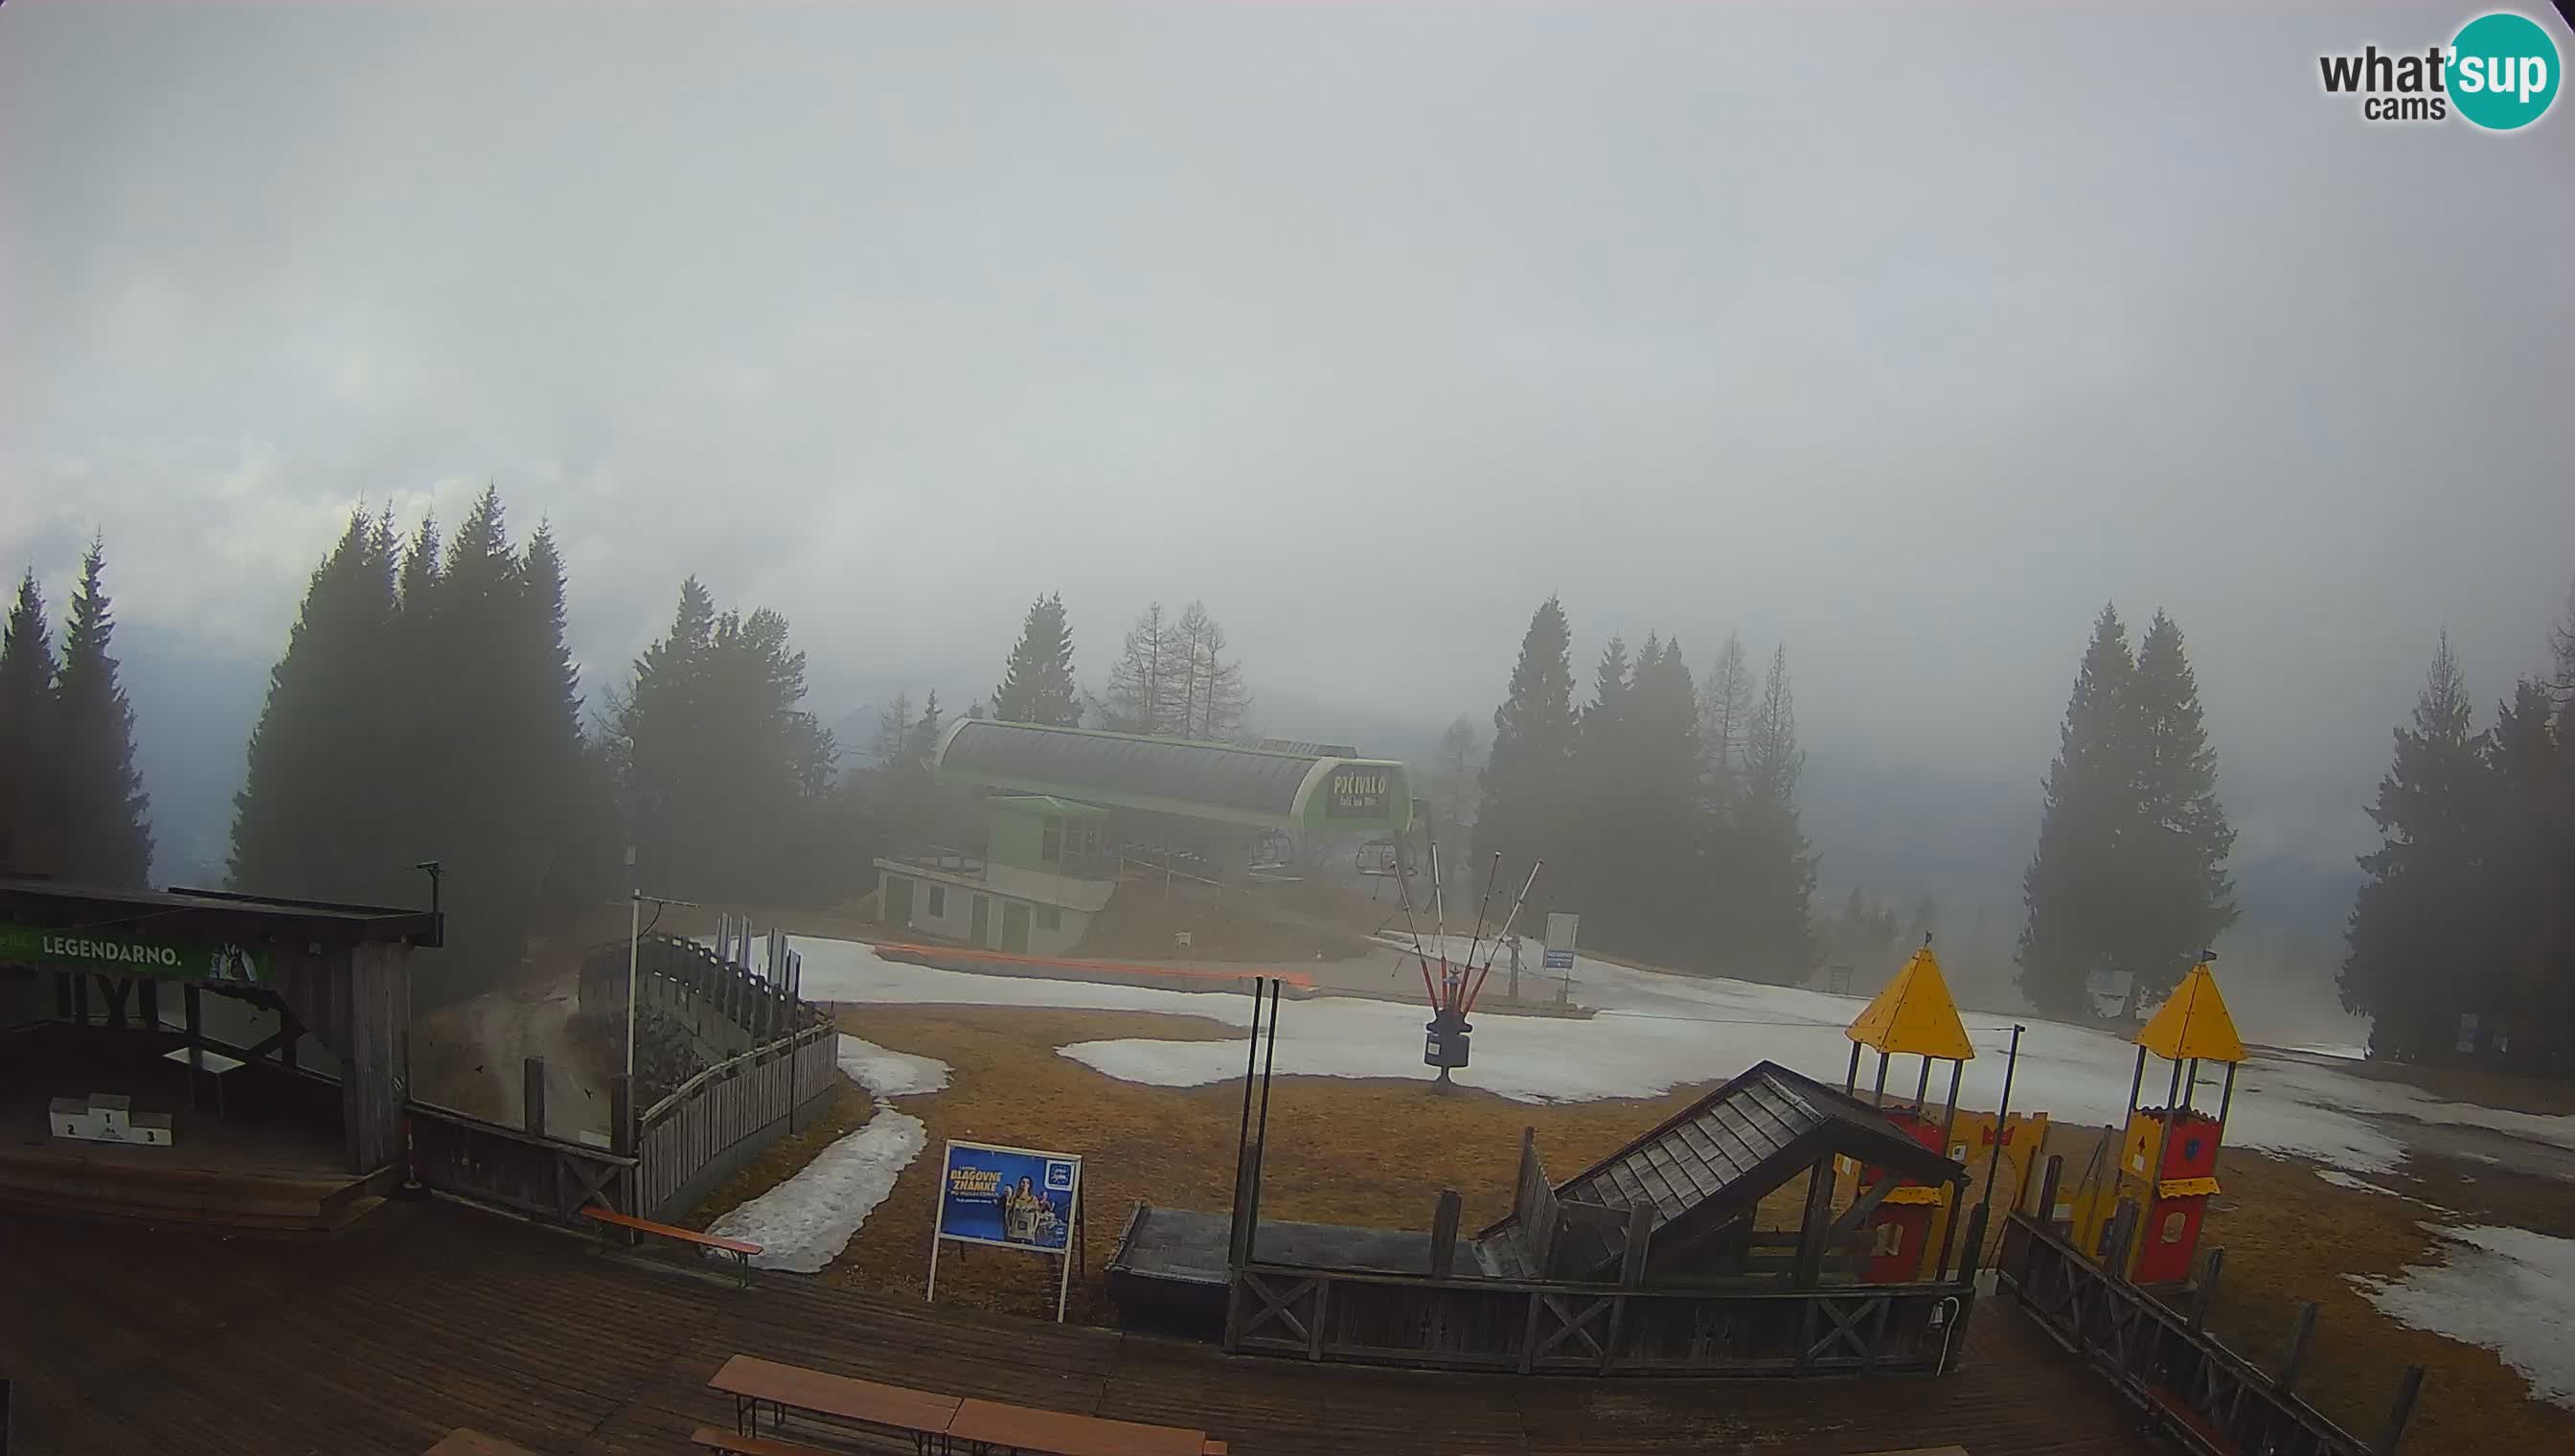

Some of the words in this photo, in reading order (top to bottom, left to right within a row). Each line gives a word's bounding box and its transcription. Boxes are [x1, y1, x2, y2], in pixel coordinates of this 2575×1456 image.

[43, 936, 182, 967] LEGENDARNO.
[104, 1112, 112, 1124] 1
[67, 1125, 76, 1135] 2
[148, 1131, 155, 1142] 3
[950, 1170, 1002, 1182] BLAGOVNE
[953, 1180, 997, 1192] ZNAMKE
